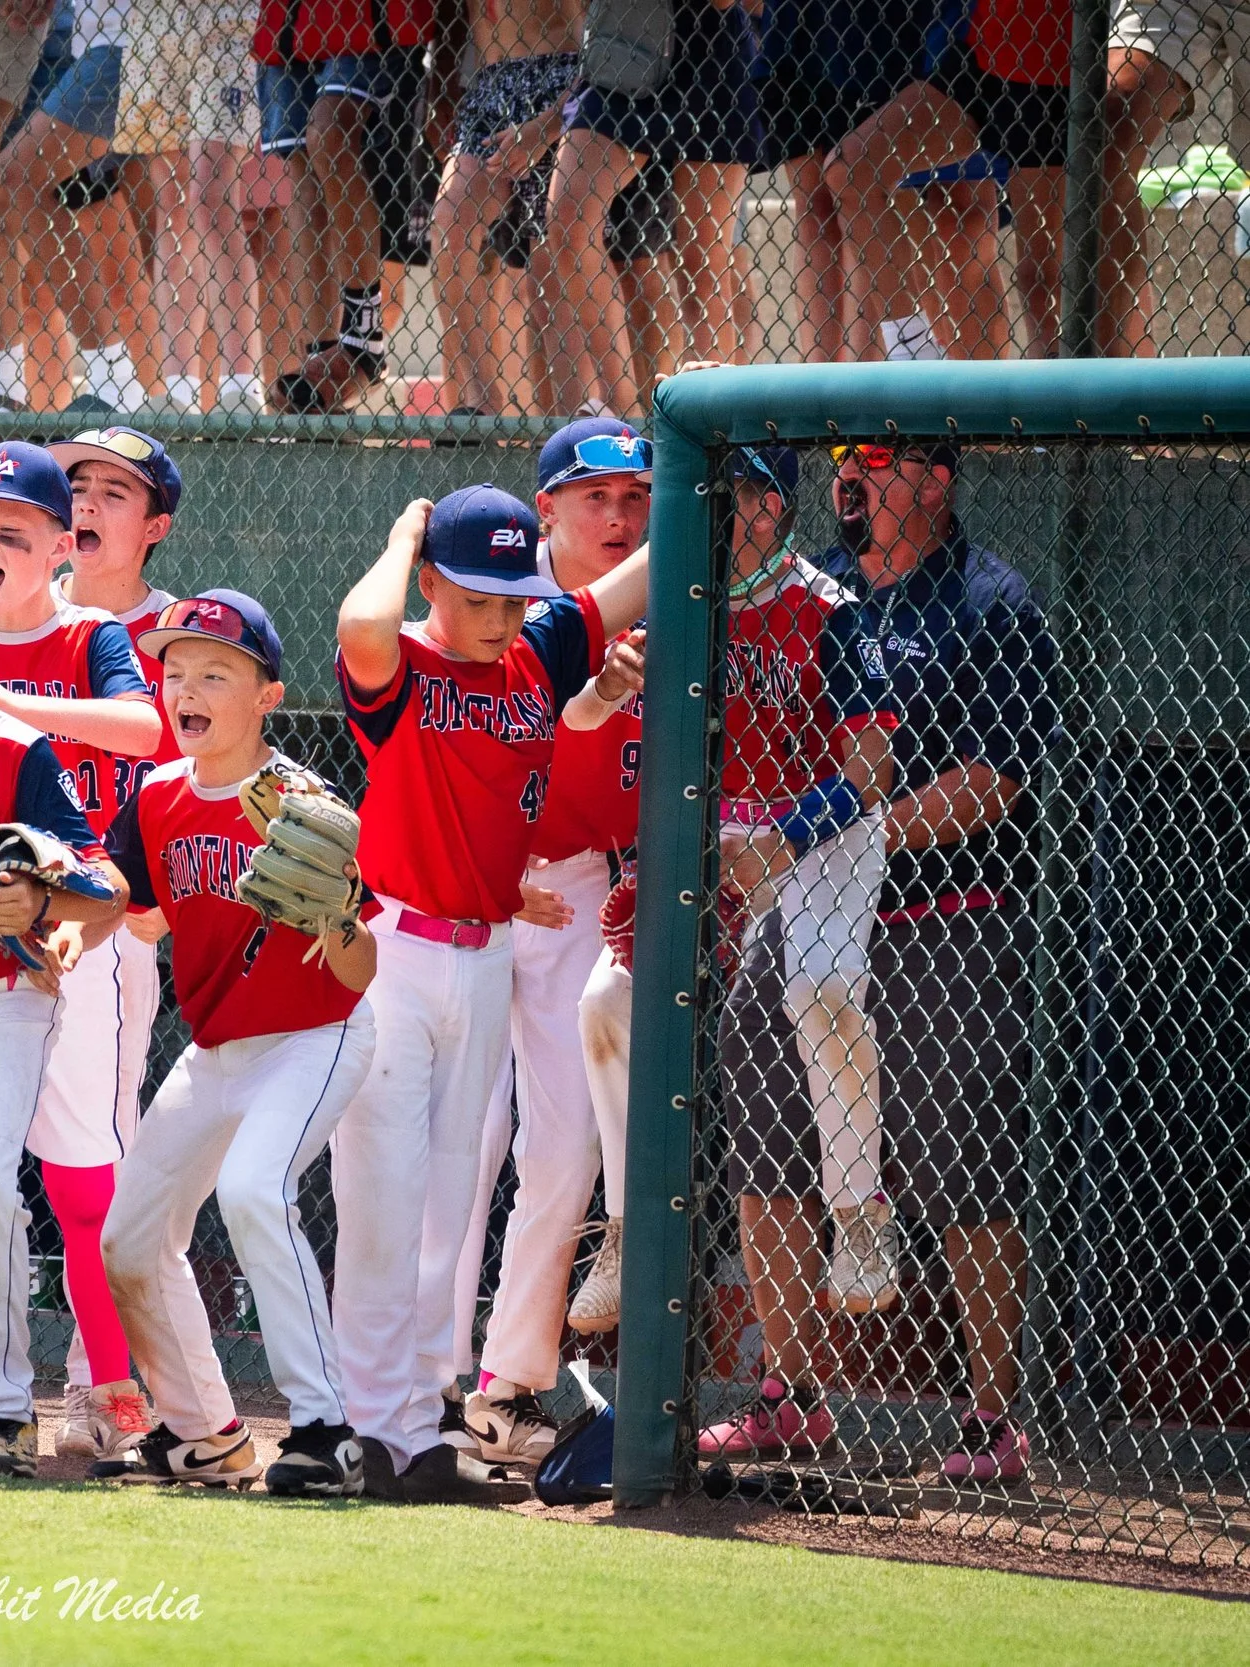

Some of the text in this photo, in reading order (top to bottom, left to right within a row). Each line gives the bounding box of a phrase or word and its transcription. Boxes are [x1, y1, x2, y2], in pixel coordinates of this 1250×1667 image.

[490, 529, 527, 548] BA
[896, 645, 927, 659] Lague
[519, 763, 552, 824] 4
[311, 806, 352, 833] A2000
